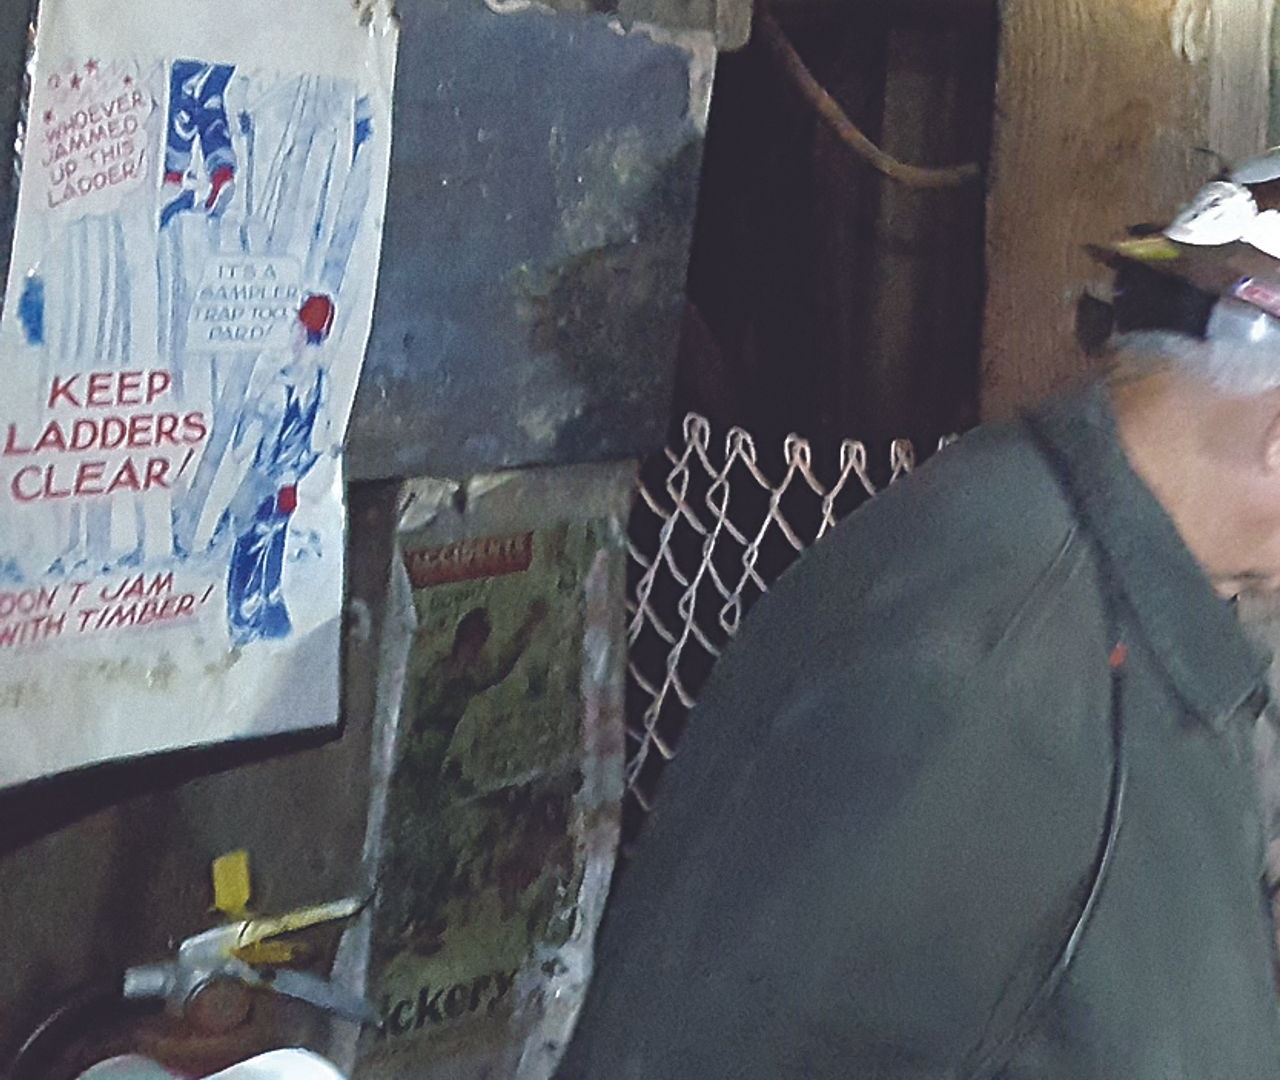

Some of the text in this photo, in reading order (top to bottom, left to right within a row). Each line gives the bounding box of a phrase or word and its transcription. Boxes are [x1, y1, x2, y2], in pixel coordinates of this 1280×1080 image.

[44, 88, 147, 145] WHOEVER
[41, 114, 139, 168] JAMMED
[51, 139, 135, 187] UP THIS
[264, 263, 278, 281] A
[47, 370, 172, 409] KEEP
[3, 411, 207, 456] LADDERS
[11, 449, 194, 501] CLEAR!
[99, 570, 174, 604] JAM
[0, 610, 67, 648] WITH
